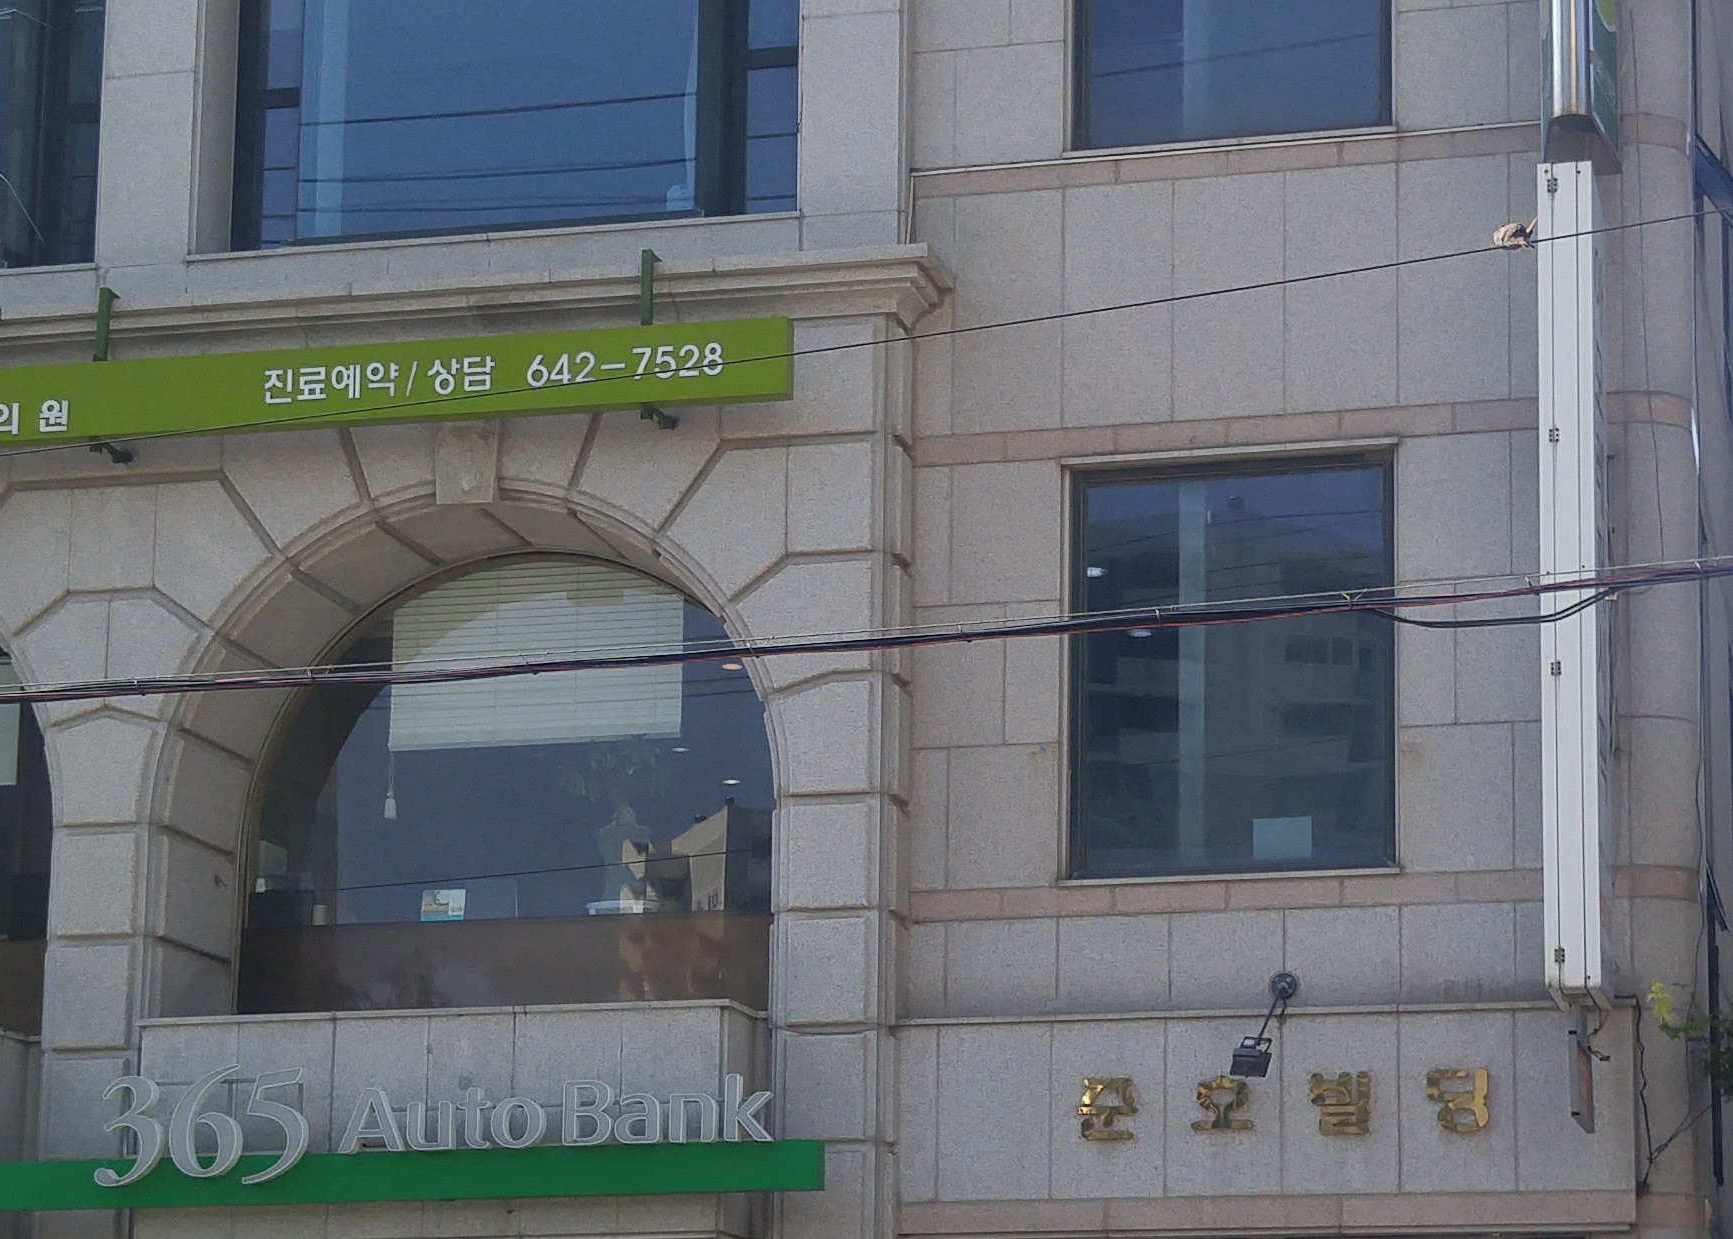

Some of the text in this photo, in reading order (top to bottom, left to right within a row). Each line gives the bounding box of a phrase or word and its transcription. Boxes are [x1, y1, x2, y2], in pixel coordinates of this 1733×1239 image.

[526, 342, 725, 389] 642-7528
[94, 1064, 776, 1188] 365 Auto Bank
